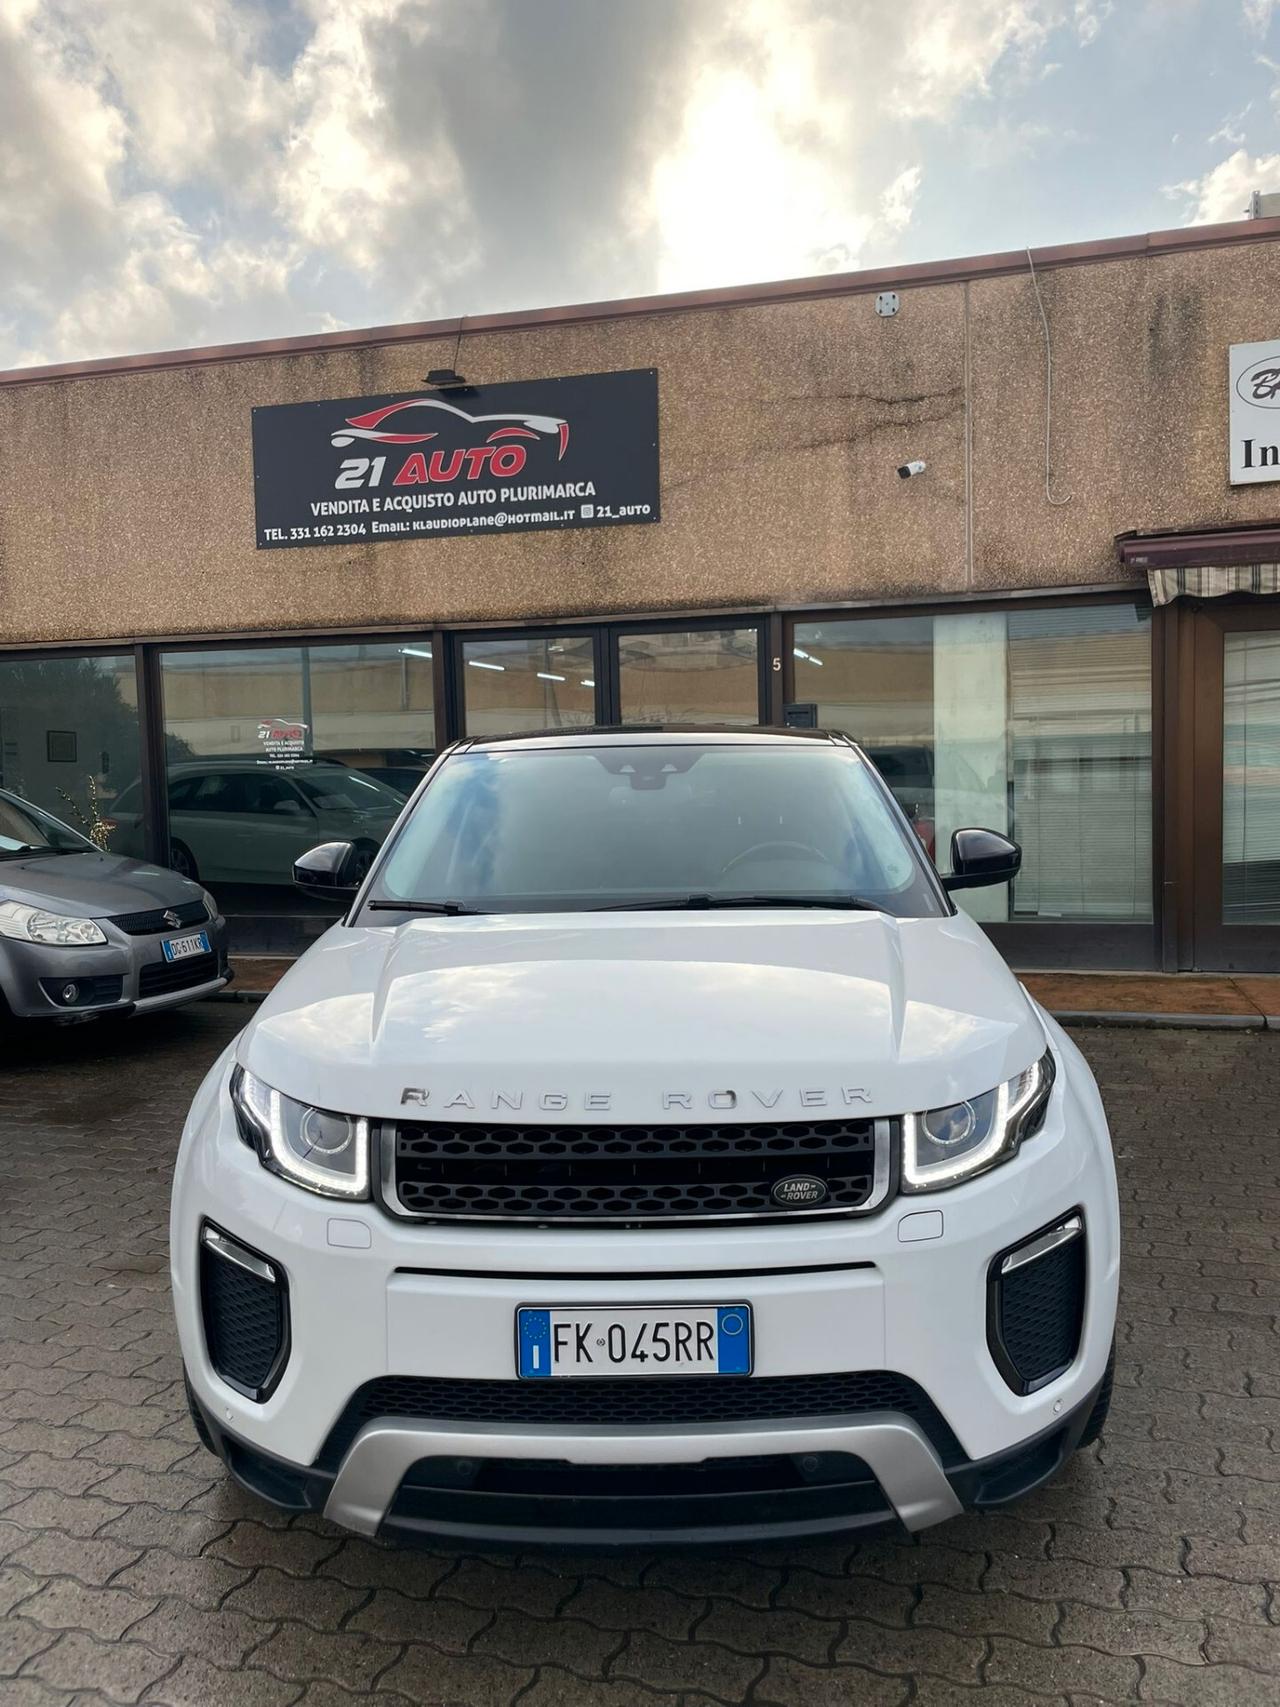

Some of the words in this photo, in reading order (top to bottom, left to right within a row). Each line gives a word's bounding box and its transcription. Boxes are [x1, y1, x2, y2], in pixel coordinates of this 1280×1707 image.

[335, 456, 387, 490] 21
[392, 444, 527, 486] AUTO
[310, 501, 370, 517] VENDITA
[372, 498, 381, 512] E
[384, 492, 455, 513] ACQUISTO
[458, 489, 497, 506] AUTO
[500, 481, 596, 503] PLURIMARCA
[264, 527, 288, 541] TEL.
[290, 526, 311, 540] 331
[314, 525, 334, 538] 162
[337, 522, 367, 536] 2304
[772, 657, 782, 671] 5
[257, 730, 271, 739] 21
[400, 1086, 612, 1112] RANGE
[662, 1086, 873, 1111] ROVER
[786, 1190, 818, 1200] ROVER
[553, 1322, 594, 1364] FK
[607, 1321, 715, 1364] 045RR
